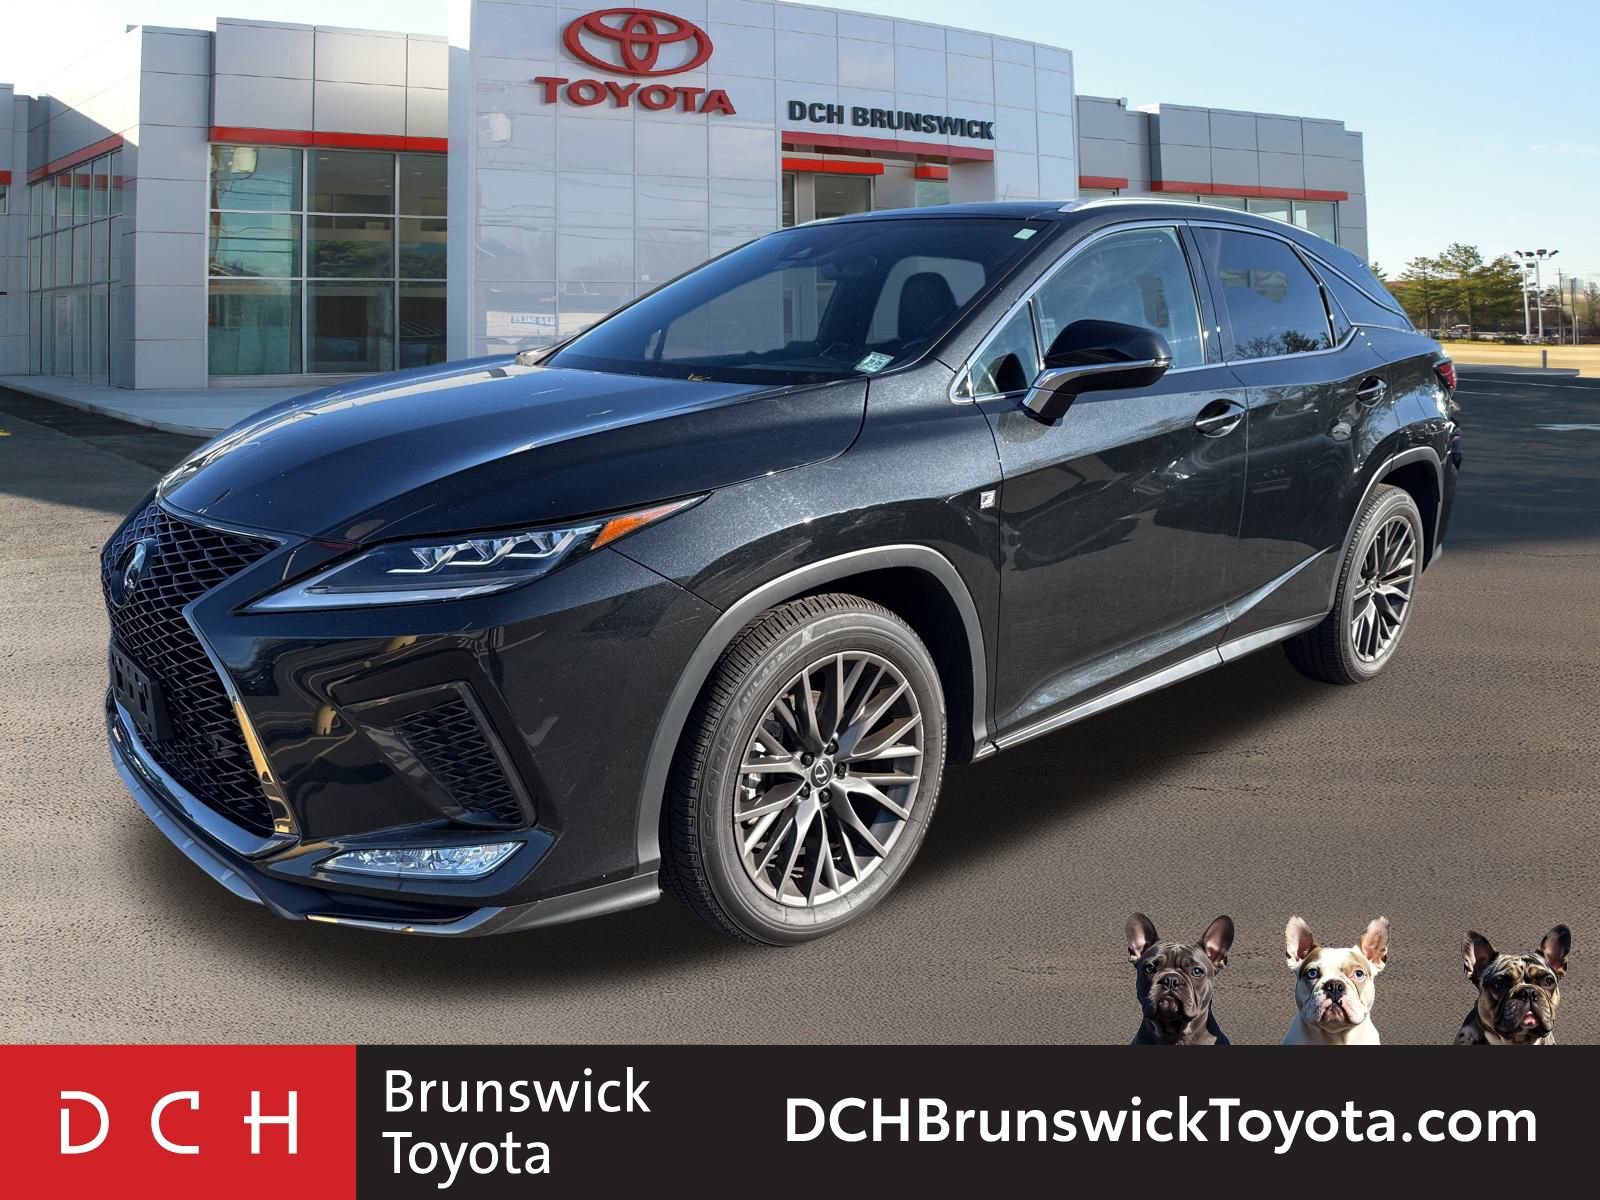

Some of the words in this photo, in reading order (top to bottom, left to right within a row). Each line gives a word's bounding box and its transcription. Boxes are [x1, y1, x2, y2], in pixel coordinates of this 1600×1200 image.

[534, 76, 736, 114] TOYOTA
[788, 100, 844, 124] DCH
[852, 106, 994, 139] BRUNSWICK
